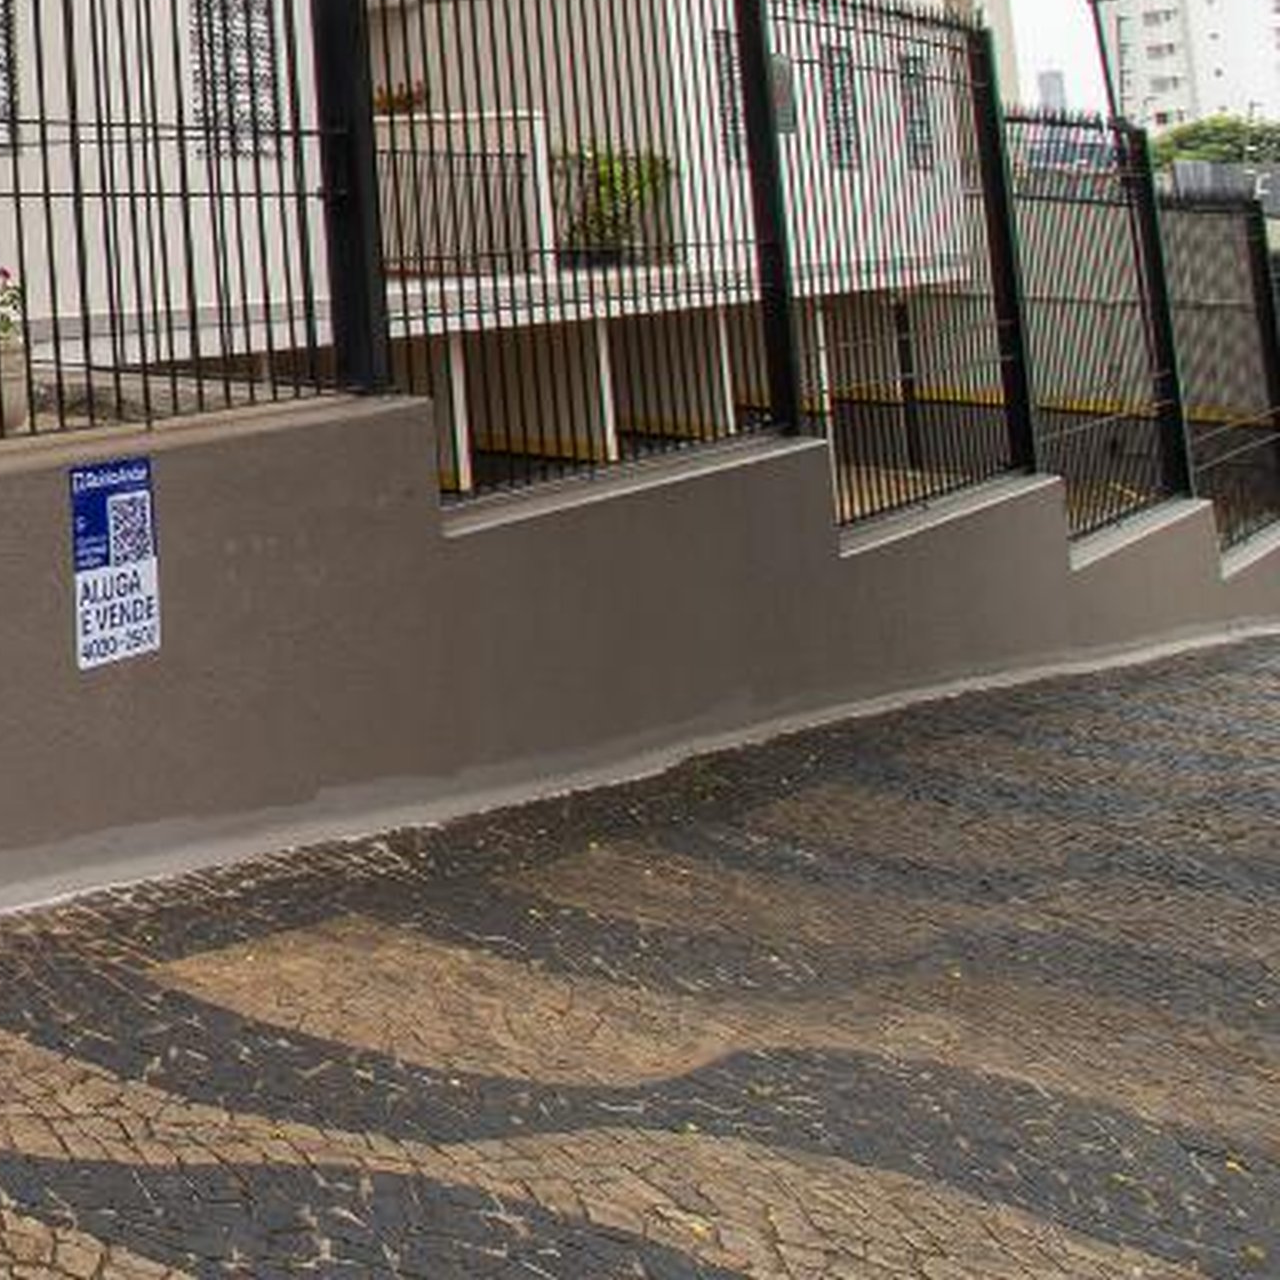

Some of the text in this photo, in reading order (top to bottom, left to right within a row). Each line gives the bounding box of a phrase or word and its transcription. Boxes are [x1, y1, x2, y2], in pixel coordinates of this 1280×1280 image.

[80, 570, 141, 608] ALUGA
[82, 595, 154, 636] E VENDE
